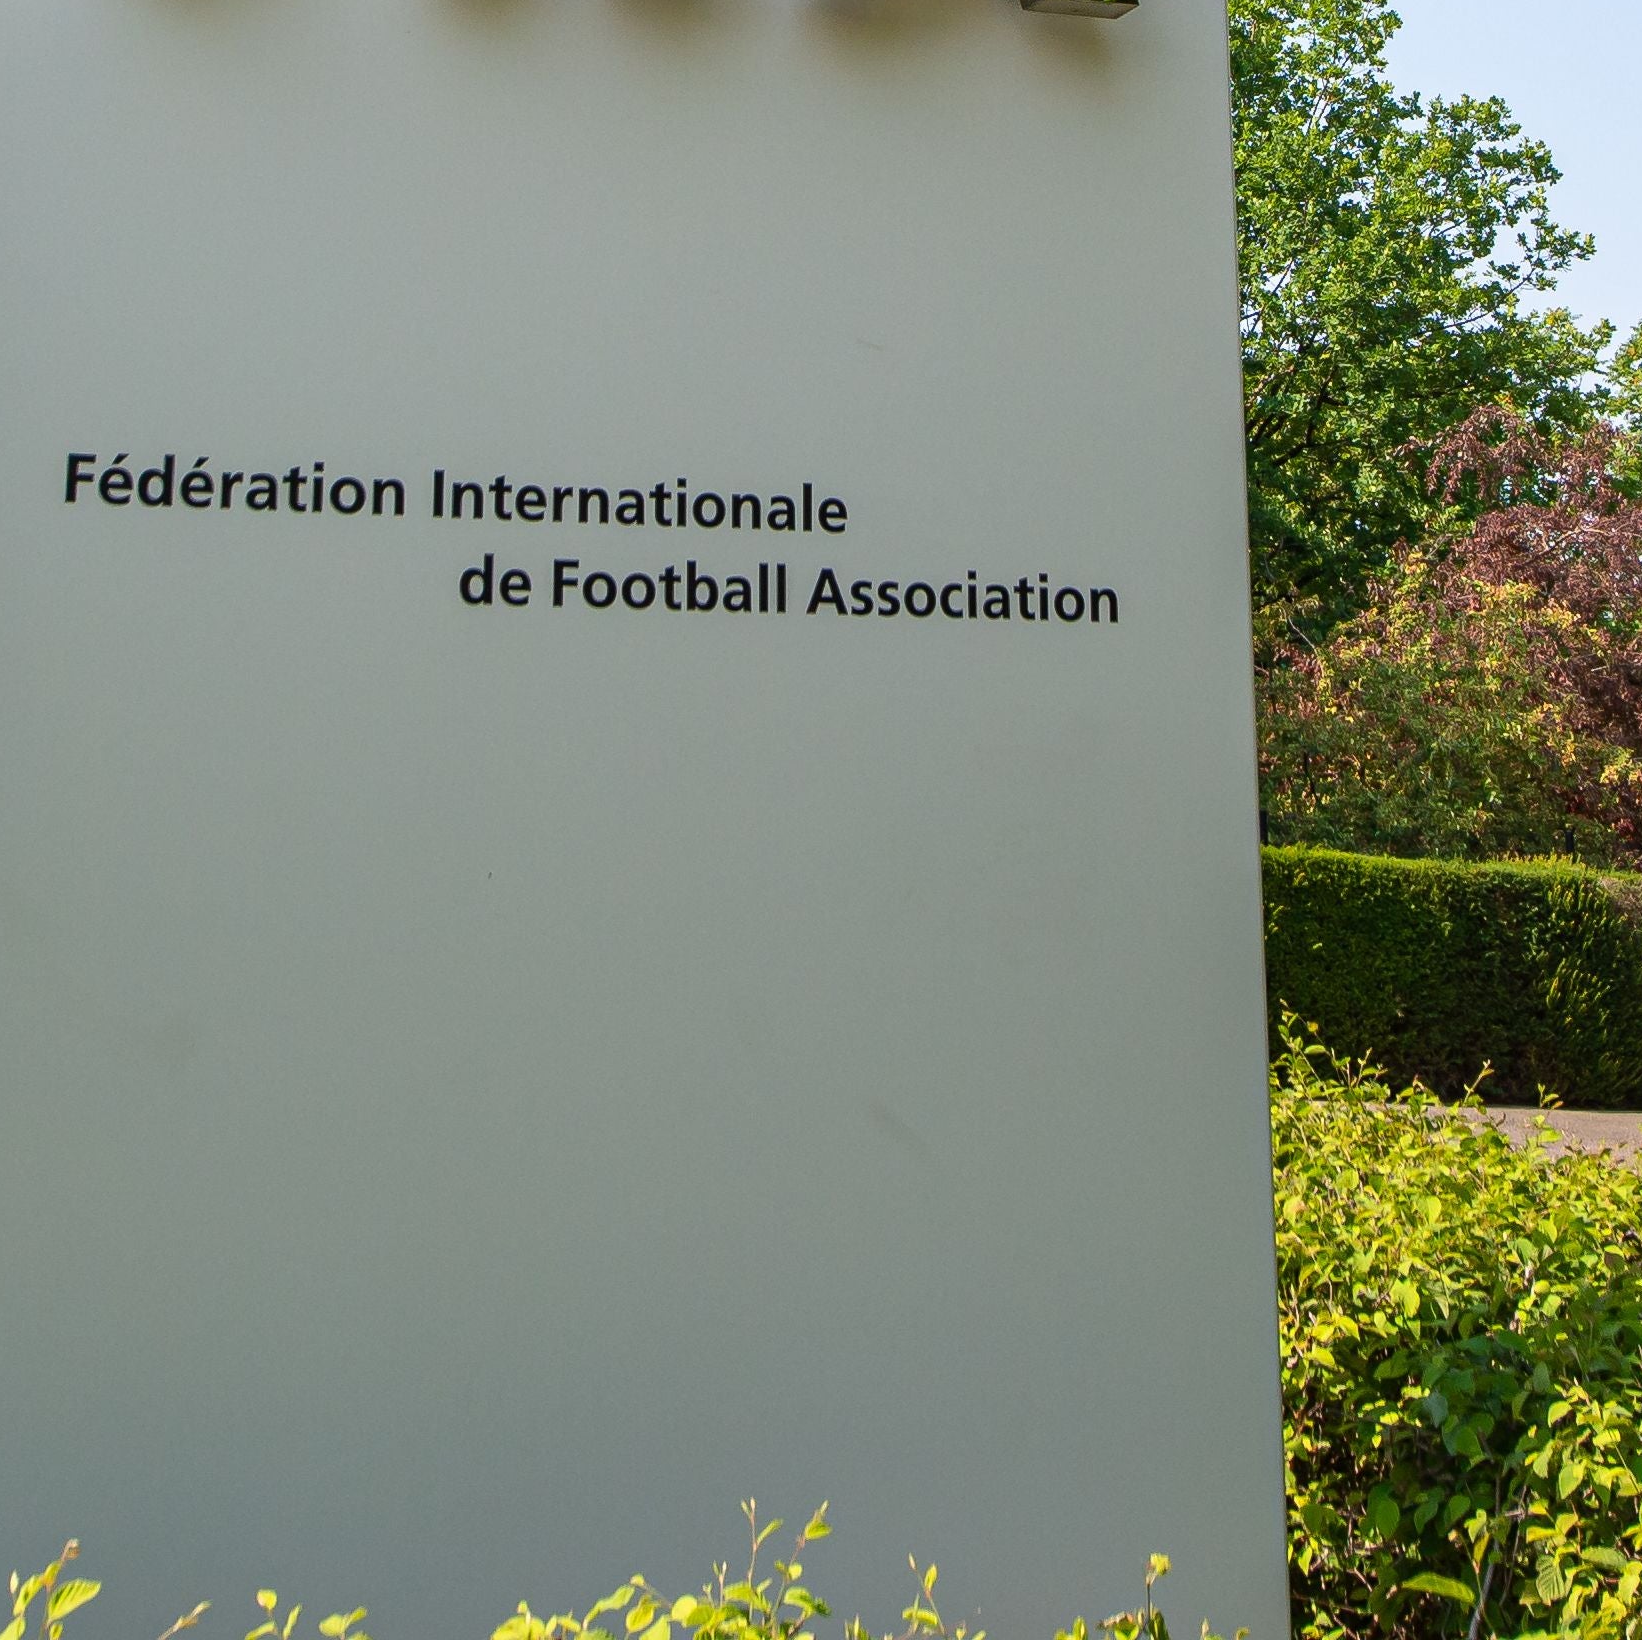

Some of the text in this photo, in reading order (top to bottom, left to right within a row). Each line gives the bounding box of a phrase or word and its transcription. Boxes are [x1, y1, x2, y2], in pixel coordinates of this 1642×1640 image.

[63, 452, 849, 535] Fédération Internationale
[458, 553, 1120, 625] de Football Association
